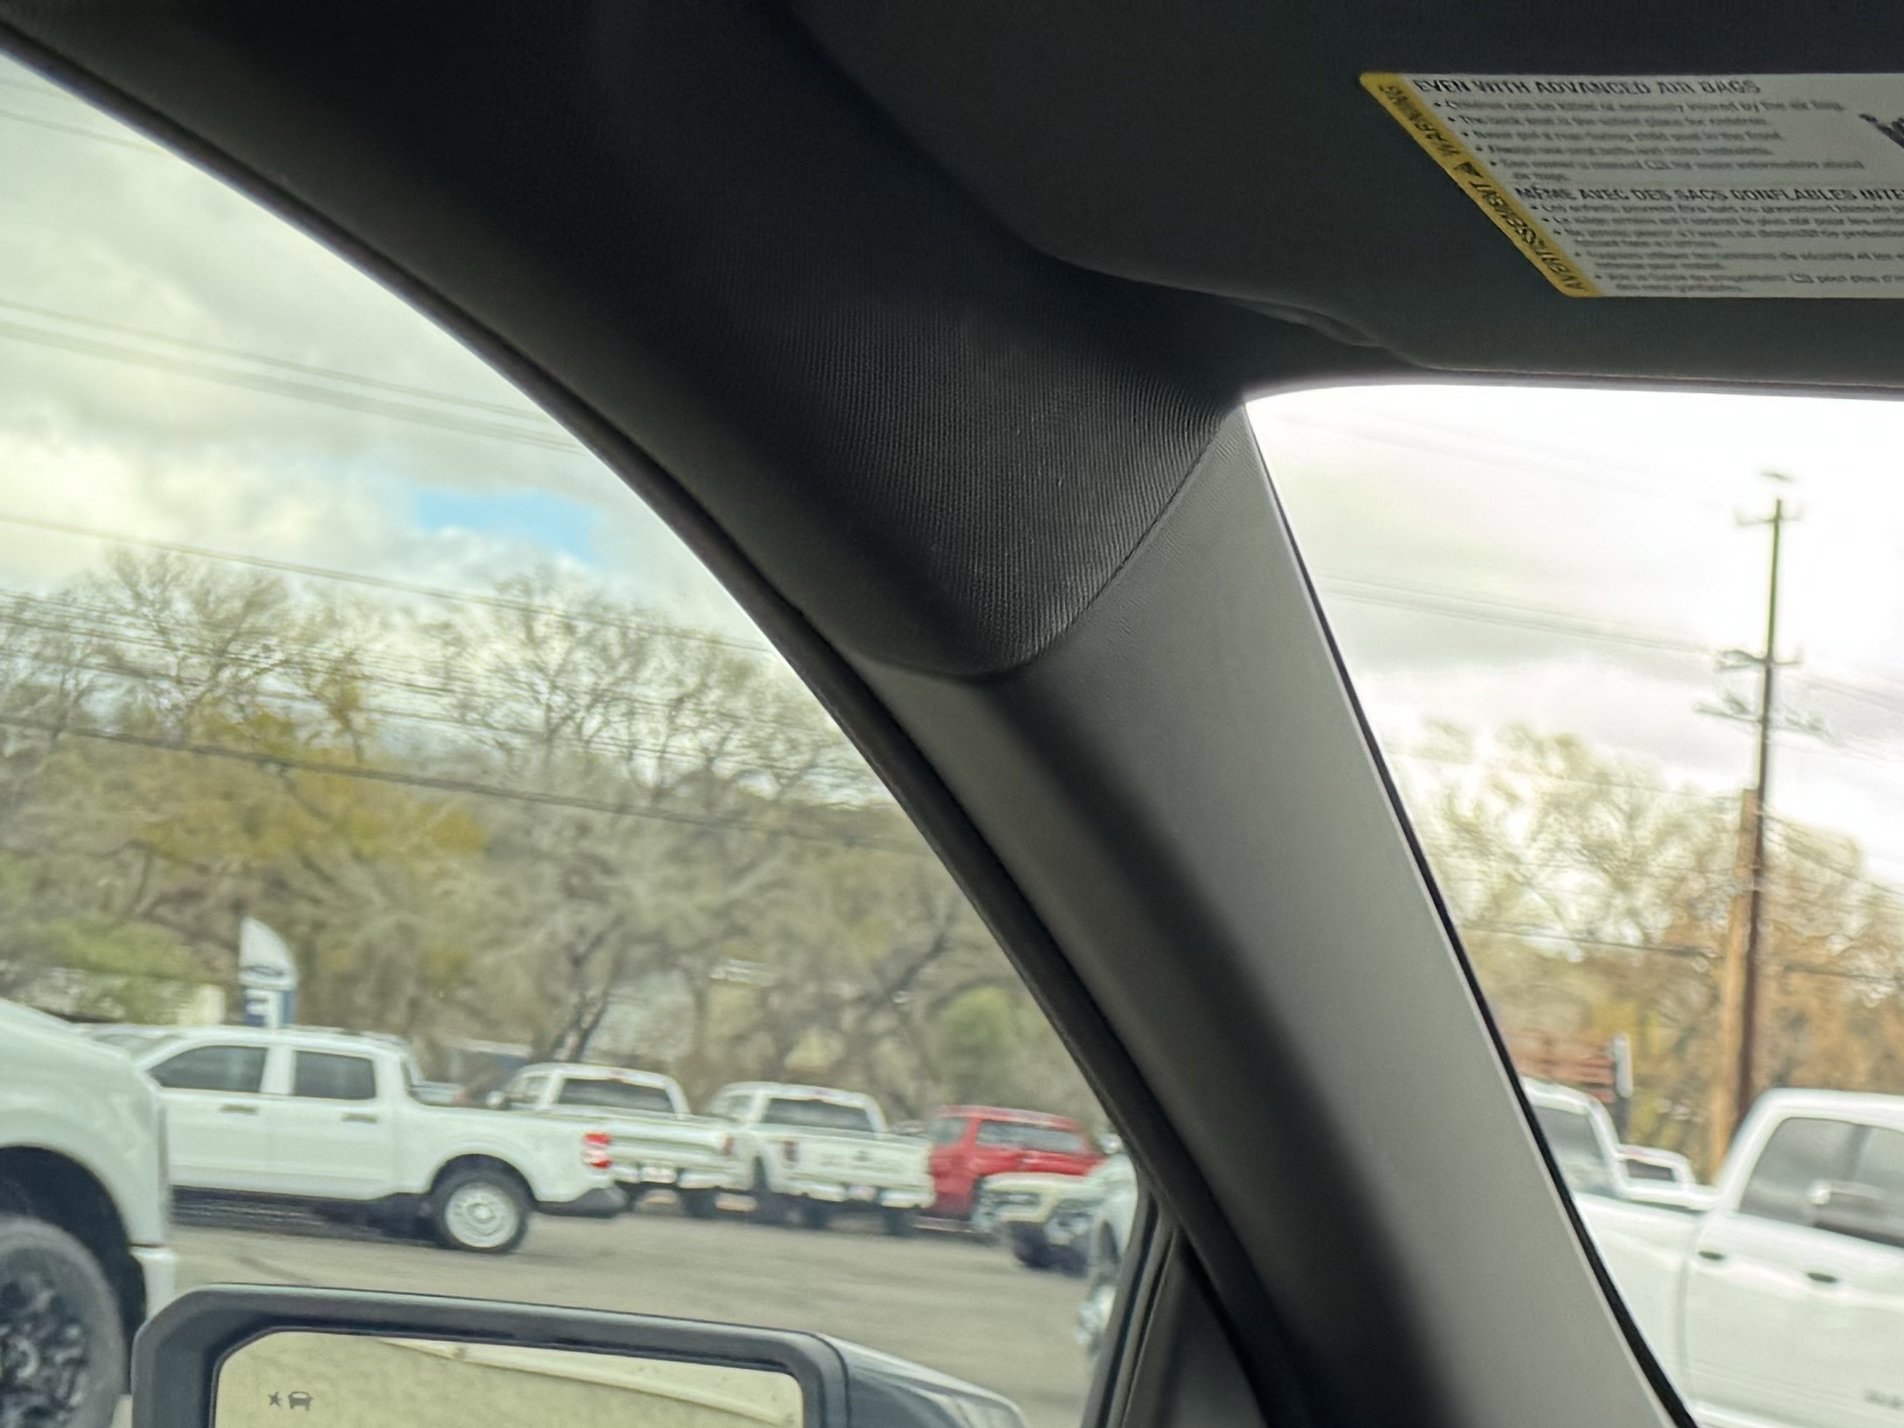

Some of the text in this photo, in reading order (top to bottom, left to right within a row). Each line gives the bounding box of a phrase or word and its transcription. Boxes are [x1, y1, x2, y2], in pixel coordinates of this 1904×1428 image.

[1412, 79, 1762, 95] EVEN WITH ADVANCED AIR BAGS
[1577, 188, 1630, 201] AVEC
[1630, 188, 1672, 201] DES
[1674, 188, 1729, 201] SACS
